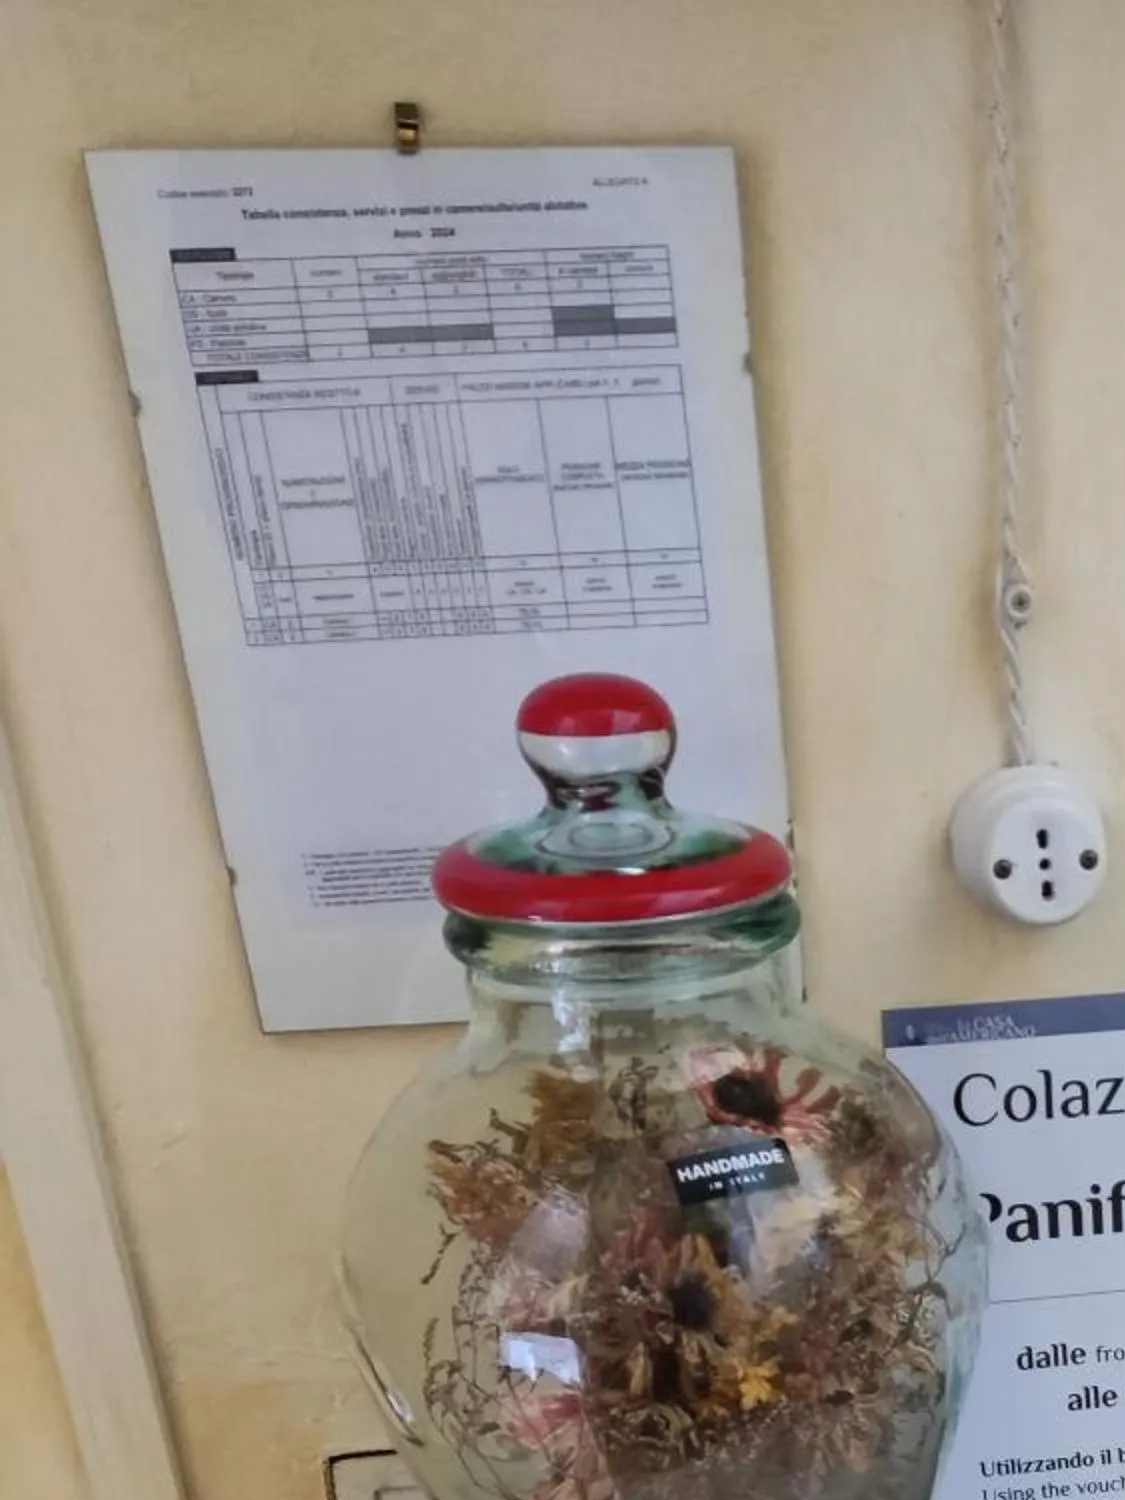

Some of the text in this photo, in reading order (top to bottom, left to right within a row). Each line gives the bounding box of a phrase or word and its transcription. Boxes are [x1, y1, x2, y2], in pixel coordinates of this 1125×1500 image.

[676, 1148, 785, 1182] HANDMADE
[1016, 1343, 1087, 1371] dalle
[1067, 1385, 1119, 1412] alle
[979, 1453, 1095, 1479] Utilizzando
[1100, 1450, 1112, 1466] il
[1041, 1478, 1071, 1500] the
